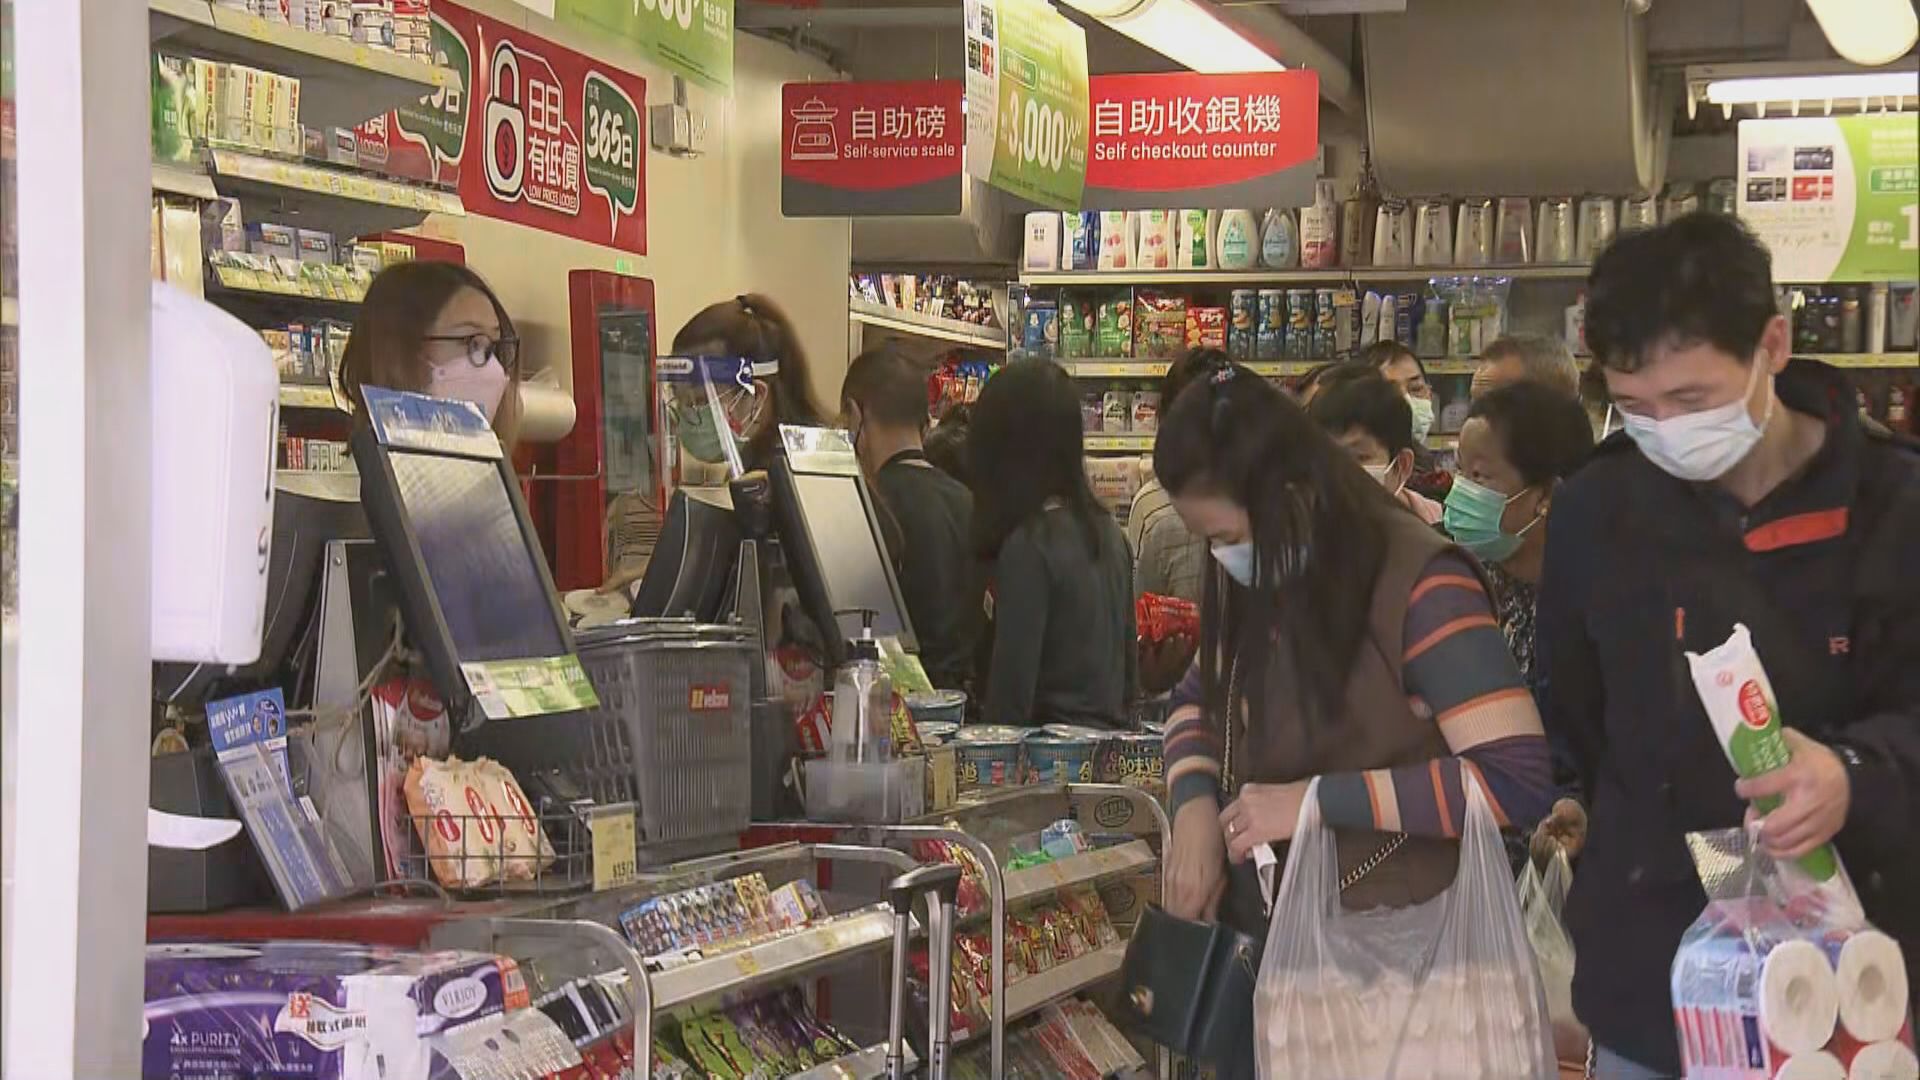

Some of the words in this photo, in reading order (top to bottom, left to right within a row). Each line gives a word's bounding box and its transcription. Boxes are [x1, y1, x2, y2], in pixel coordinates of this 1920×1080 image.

[528, 79, 561, 136] 日日
[851, 104, 946, 141] 自助磅
[1094, 94, 1281, 137] 自助收銀機
[586, 104, 633, 169] 365日
[843, 143, 917, 158] Self-service
[921, 143, 955, 157] scale
[1008, 89, 1065, 173] 3,000
[1095, 141, 1127, 161] Self
[1131, 140, 1208, 159] checkout
[1212, 140, 1277, 158] counter
[528, 132, 578, 191] 有低價
[191, 1031, 241, 1047] PURITY
